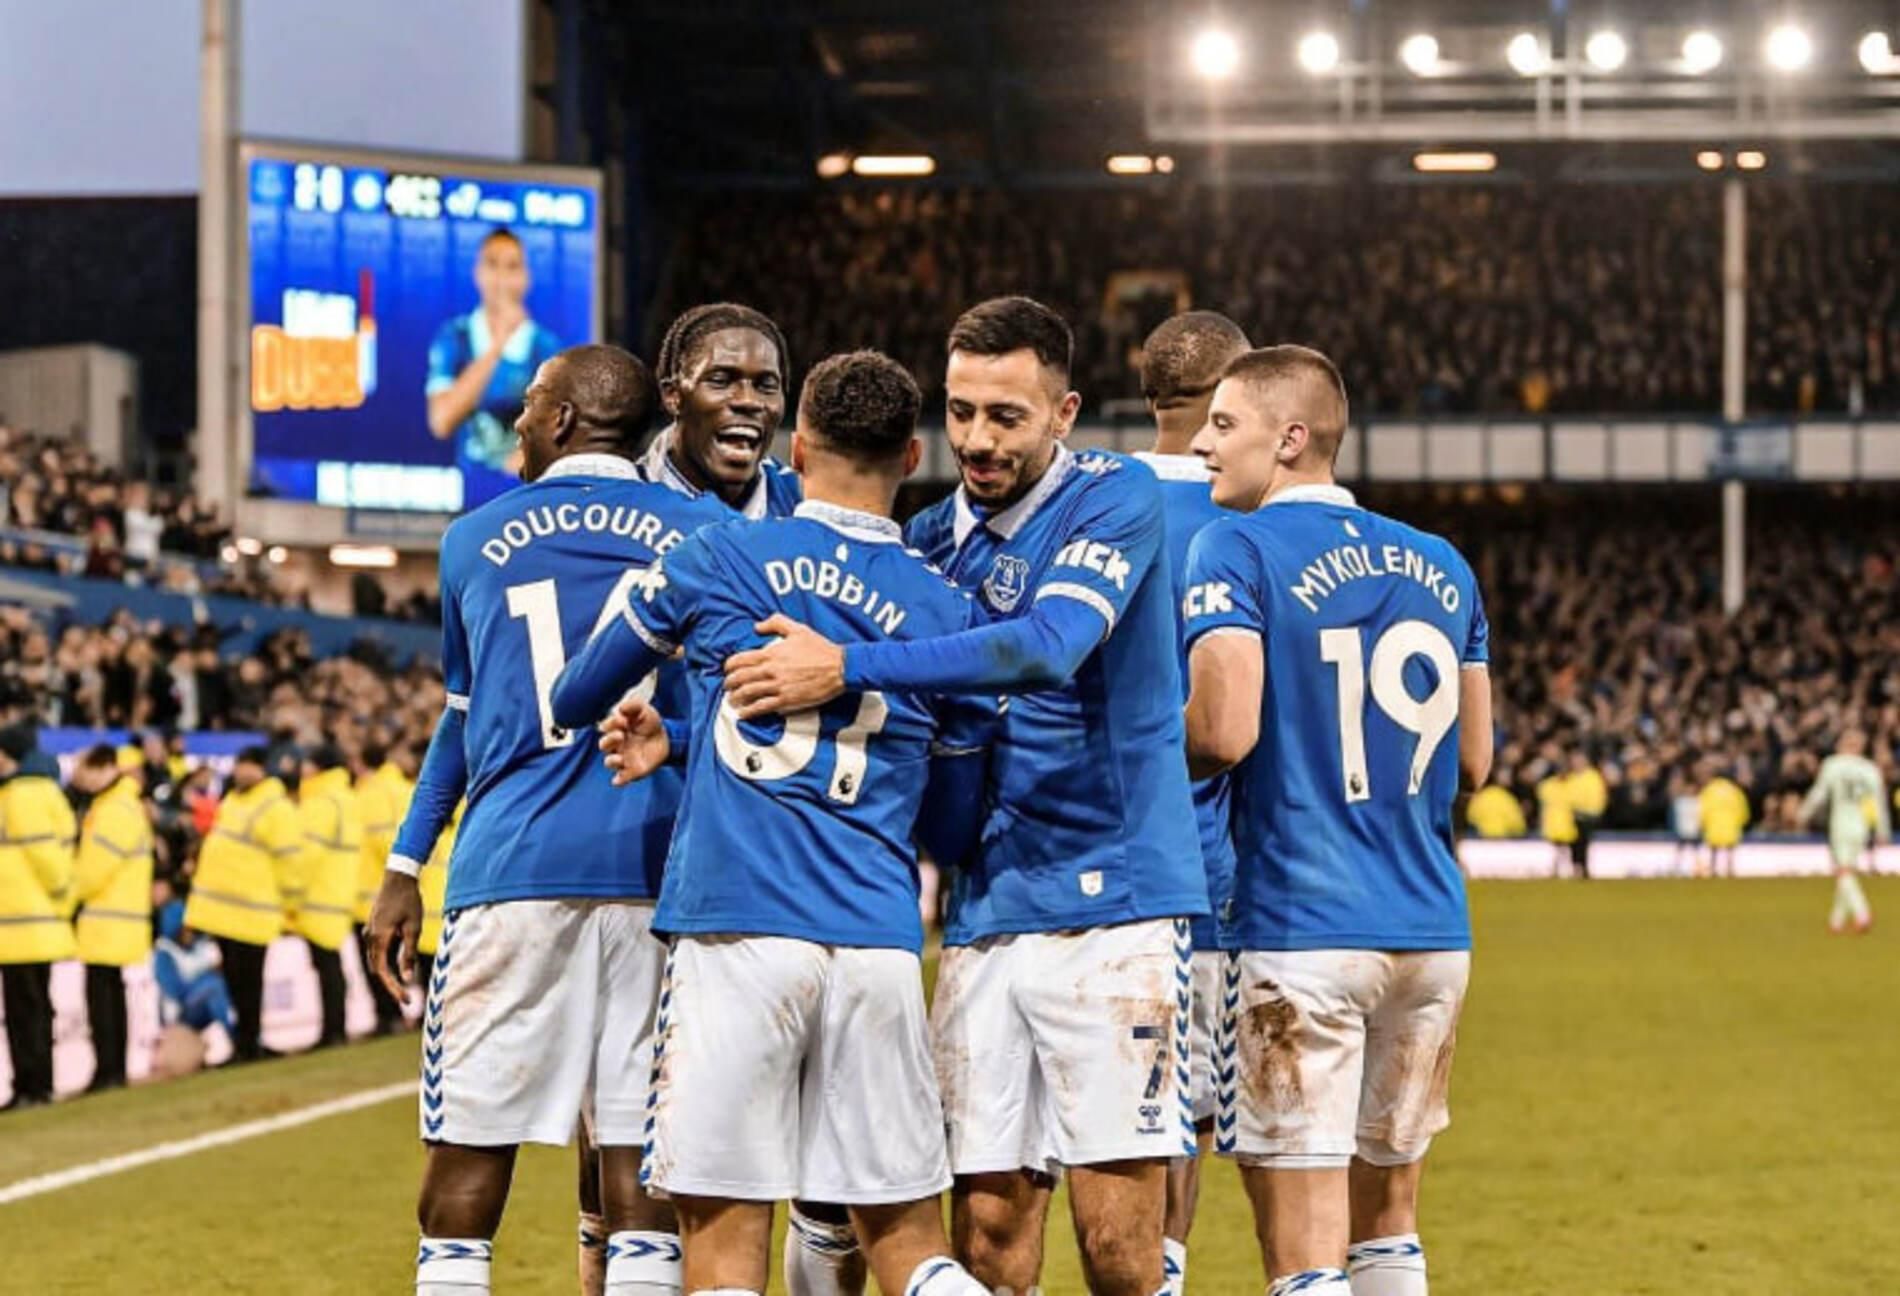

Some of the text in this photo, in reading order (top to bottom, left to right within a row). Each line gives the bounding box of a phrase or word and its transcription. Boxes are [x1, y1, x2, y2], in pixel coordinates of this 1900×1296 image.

[481, 503, 685, 566] DOUCOURE
[765, 556, 906, 635] DOBBIN
[1290, 545, 1459, 613] MYKOLENKO
[1319, 620, 1460, 803] 19
[1133, 1026, 1169, 1099] 7
